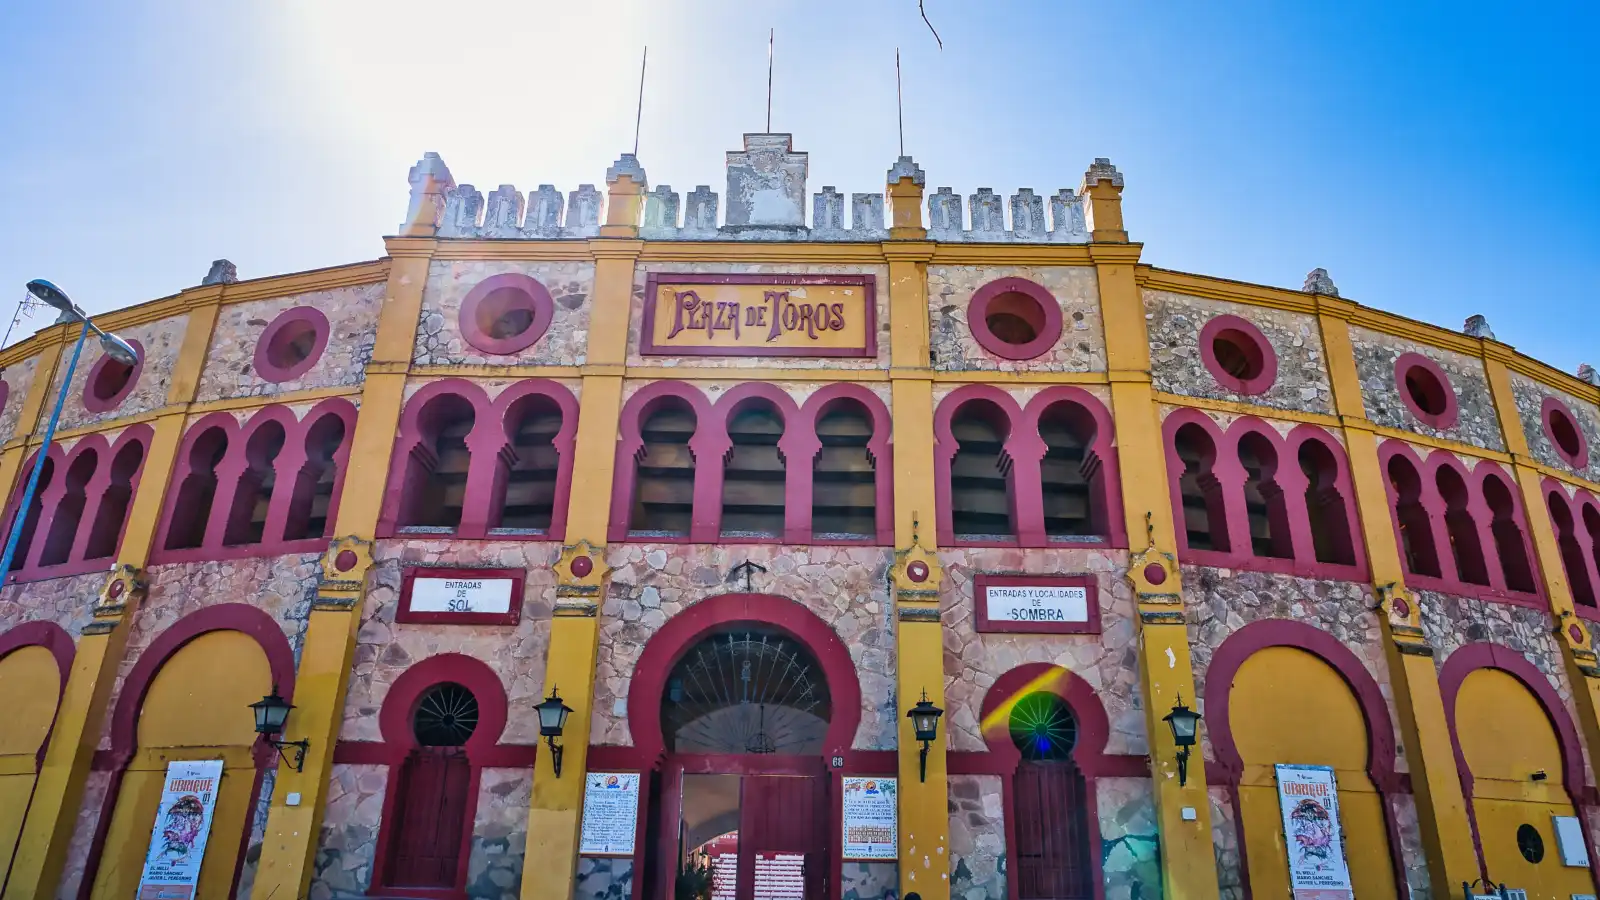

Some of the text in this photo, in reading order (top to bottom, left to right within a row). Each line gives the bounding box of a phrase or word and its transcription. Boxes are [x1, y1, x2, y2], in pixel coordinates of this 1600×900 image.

[667, 290, 845, 342] PLAZA DE TOROS
[444, 581, 482, 589] ENTRADAS
[456, 590, 467, 598] DE
[989, 589, 1084, 599] ENTRADAS Y LOCALIDADES
[447, 599, 473, 612] SOL
[1032, 599, 1042, 607] DE
[832, 756, 843, 767] 68
[170, 779, 213, 793] UBRIQUE
[1283, 782, 1329, 798] UBRIQUE
